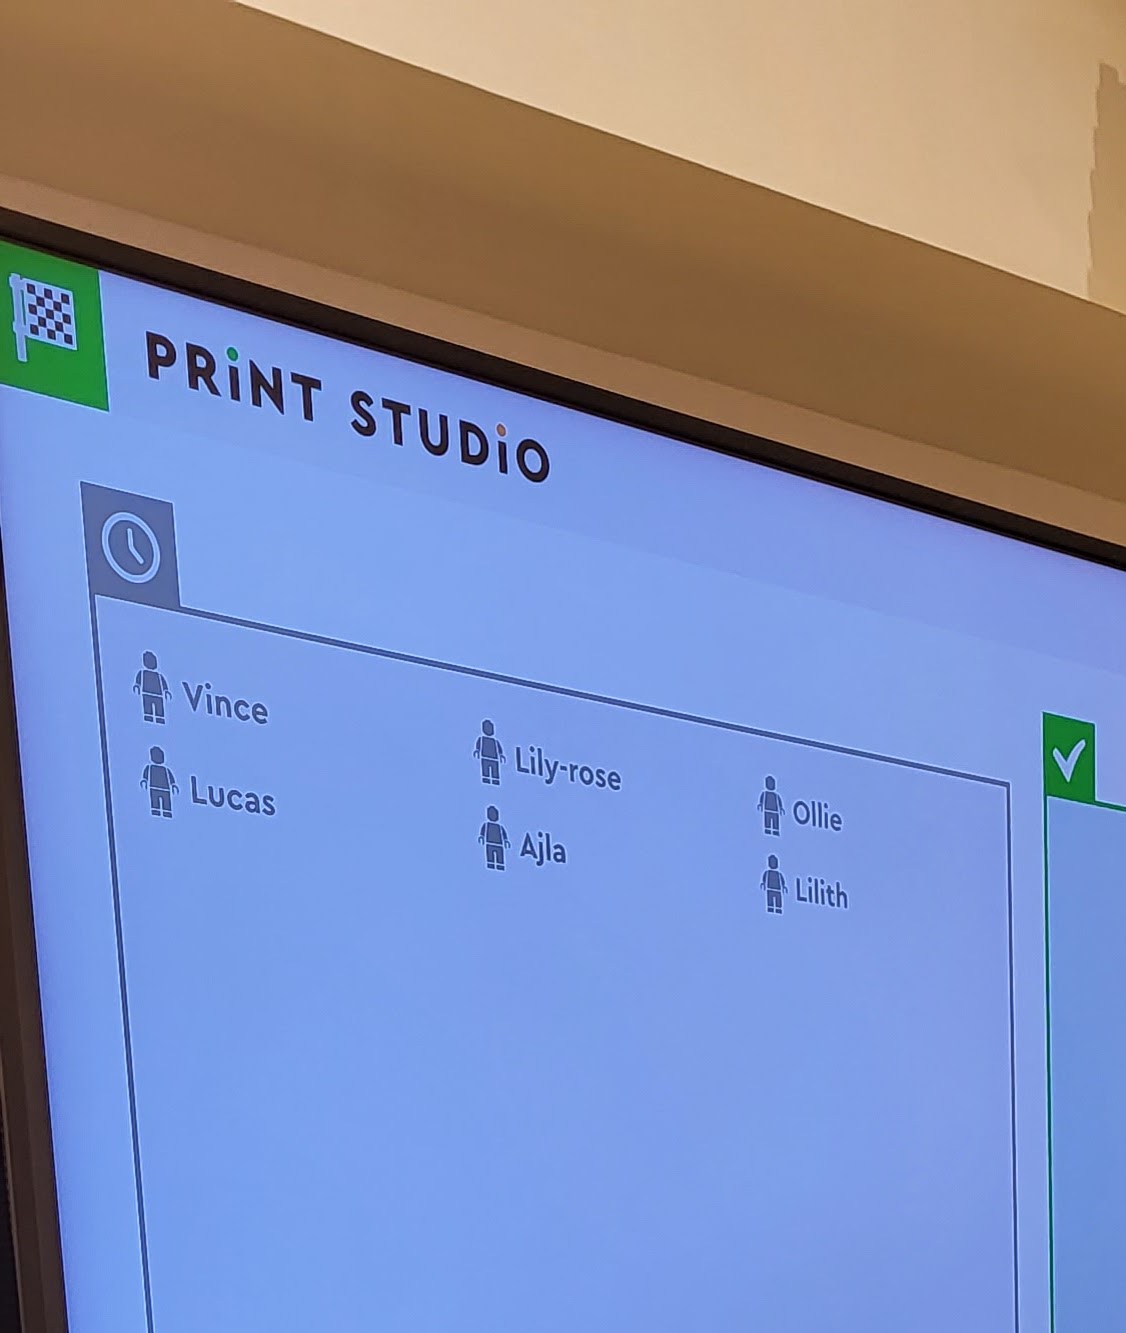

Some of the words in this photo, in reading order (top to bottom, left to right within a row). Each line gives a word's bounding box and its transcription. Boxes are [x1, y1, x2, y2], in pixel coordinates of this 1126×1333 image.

[182, 681, 269, 724] Vince
[514, 745, 622, 791] Lily-rose
[189, 776, 276, 817] Lucas
[792, 800, 843, 832] Ollie
[520, 832, 567, 865] Ajla
[795, 877, 849, 909] Lilith
